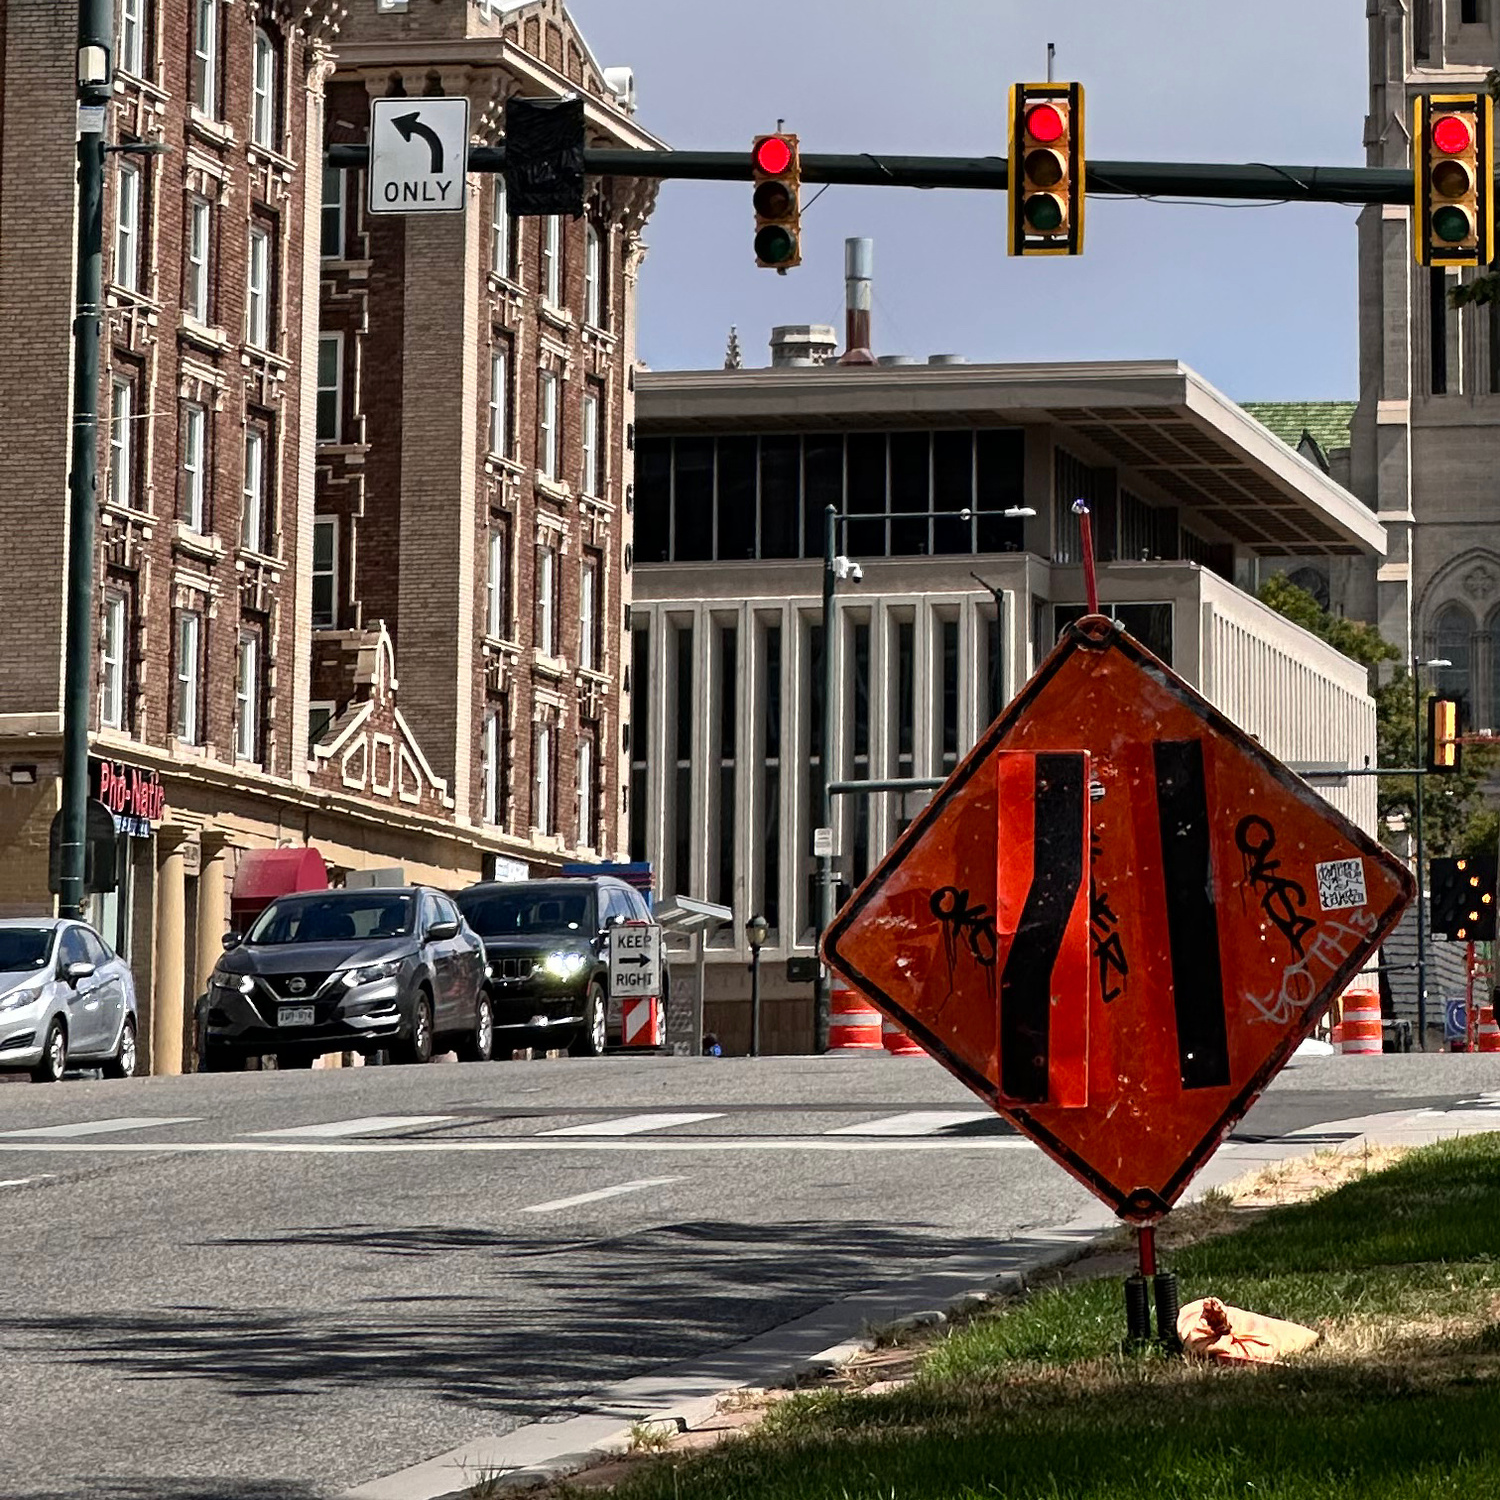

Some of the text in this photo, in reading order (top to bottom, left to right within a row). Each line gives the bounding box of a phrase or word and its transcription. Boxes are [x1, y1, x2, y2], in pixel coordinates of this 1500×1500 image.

[384, 181, 452, 202] ONLY
[617, 935, 652, 948] KEEP
[615, 972, 653, 987] RIGHT
